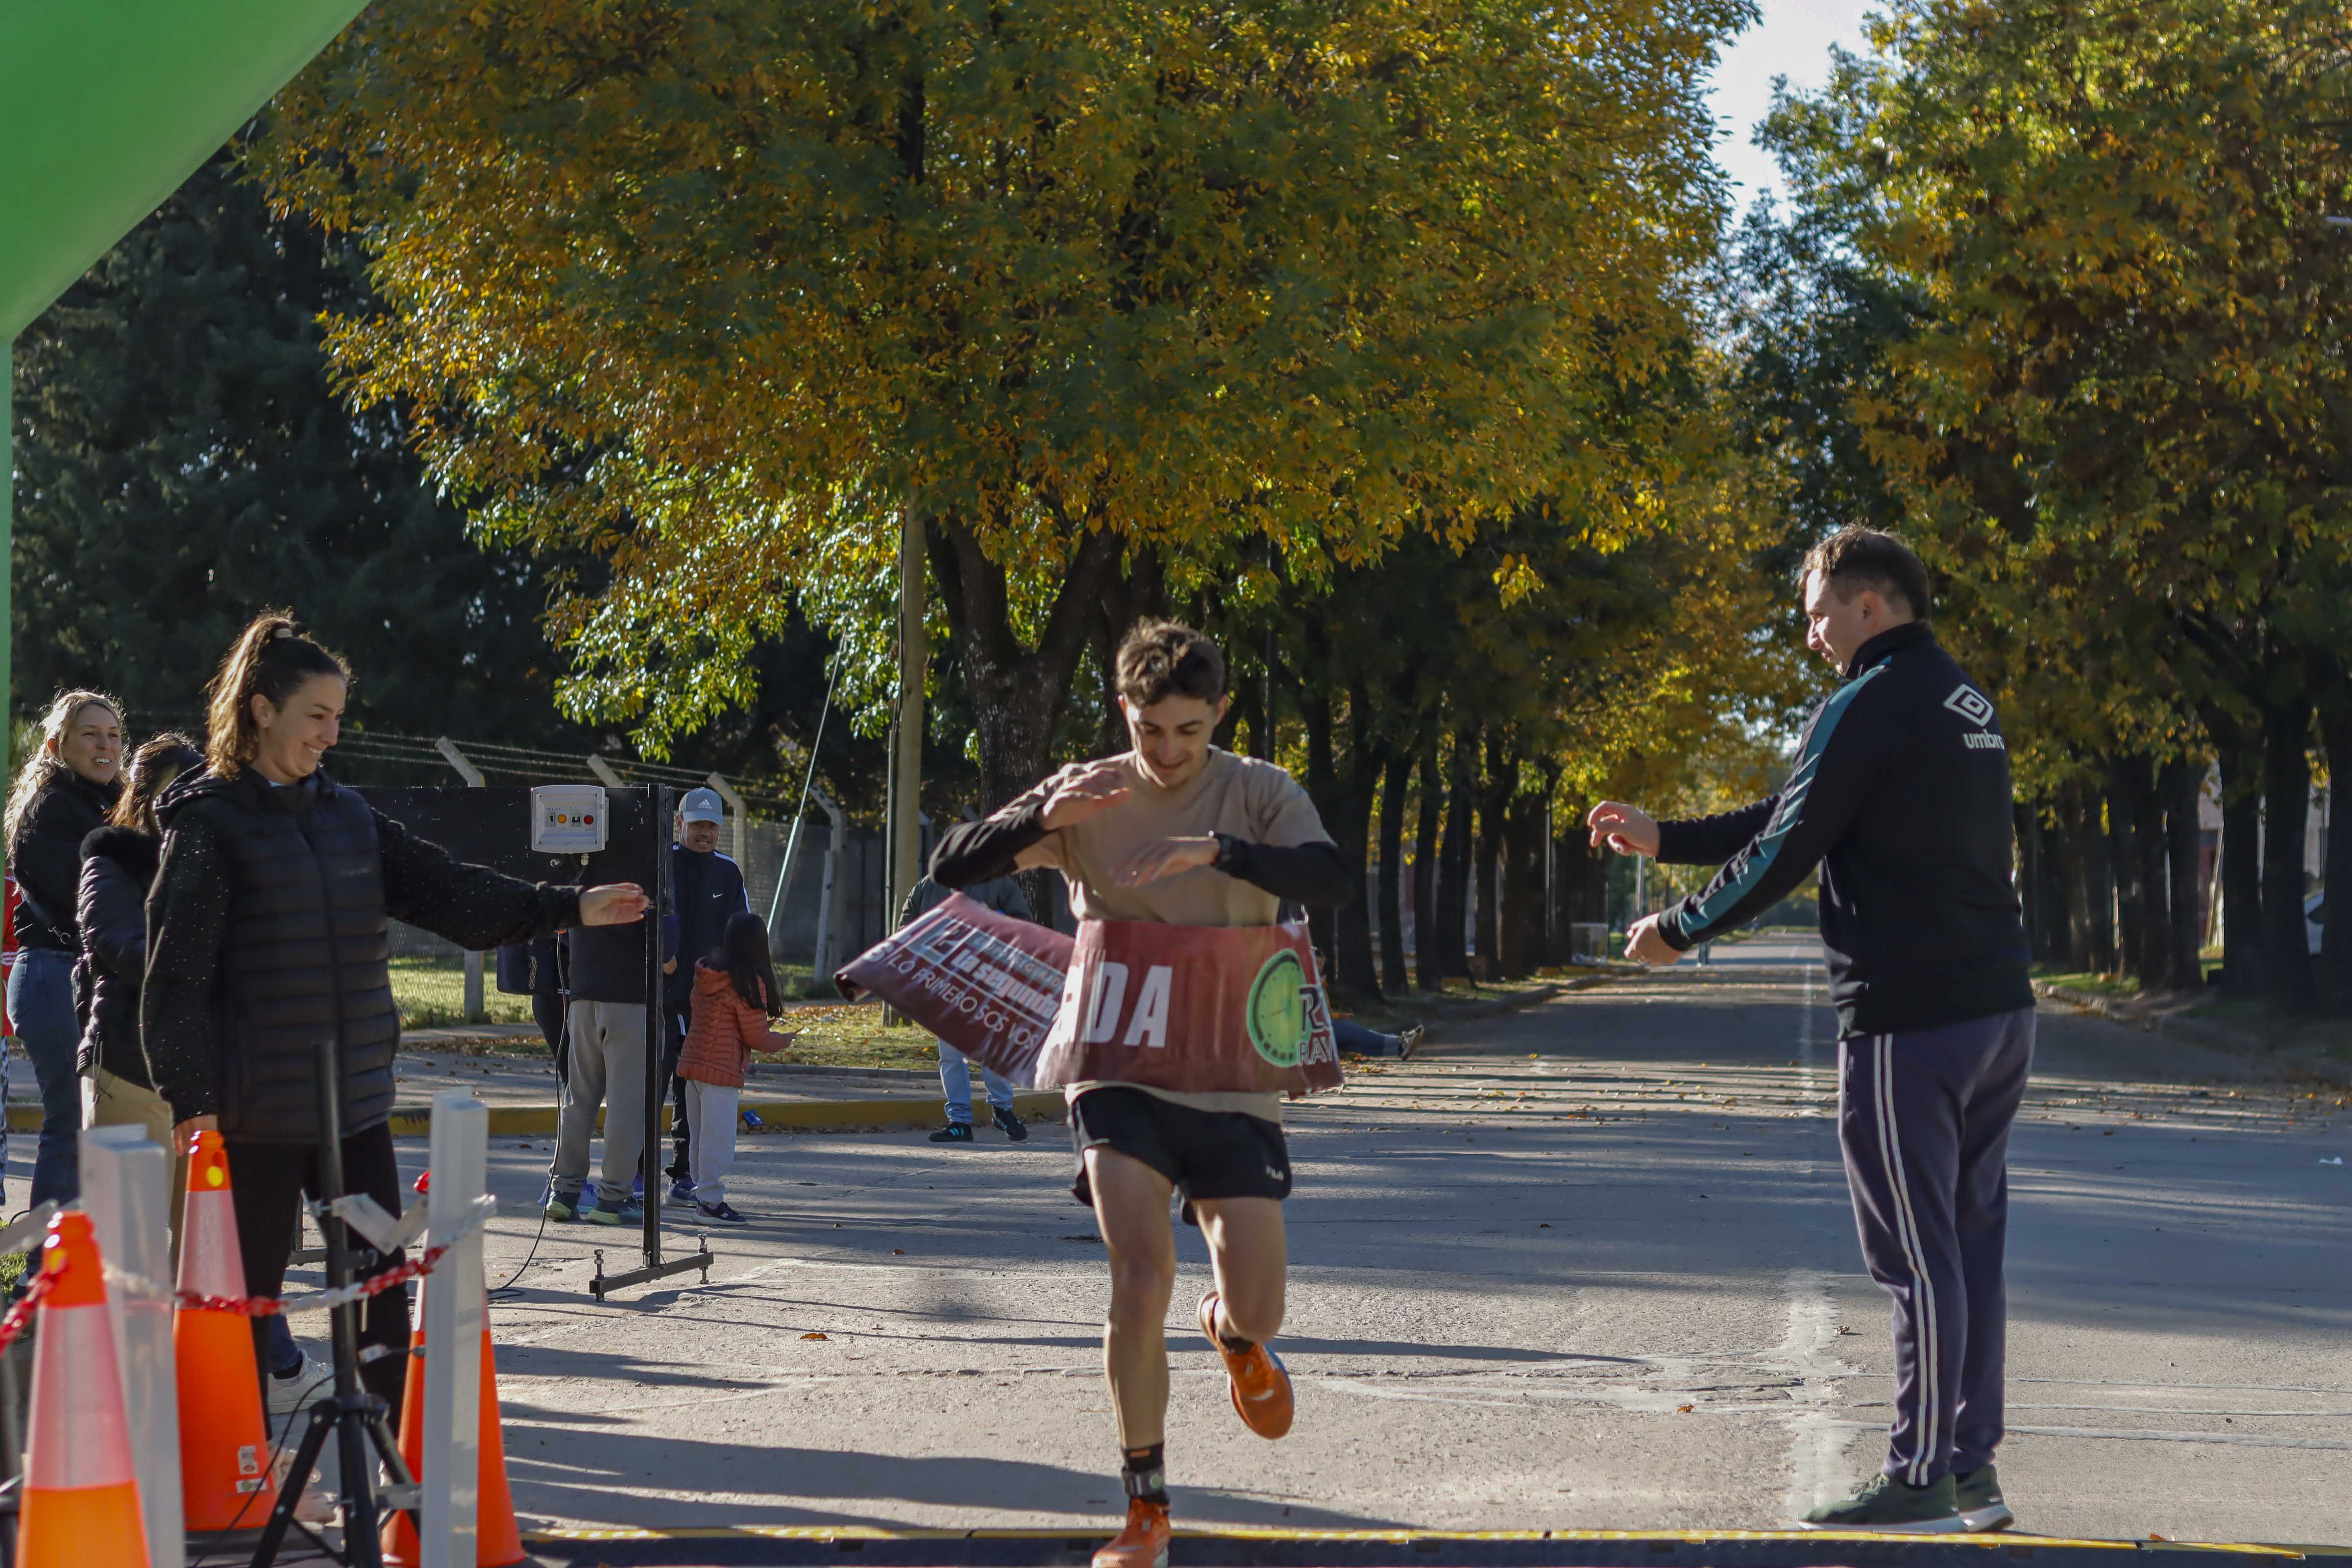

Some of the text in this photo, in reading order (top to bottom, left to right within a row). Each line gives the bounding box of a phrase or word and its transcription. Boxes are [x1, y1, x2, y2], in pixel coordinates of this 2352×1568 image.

[1963, 728, 2005, 750] umbro
[886, 953, 1039, 1050] LO PRIMERO SOS VOS
[973, 962, 1060, 1019] segunda
